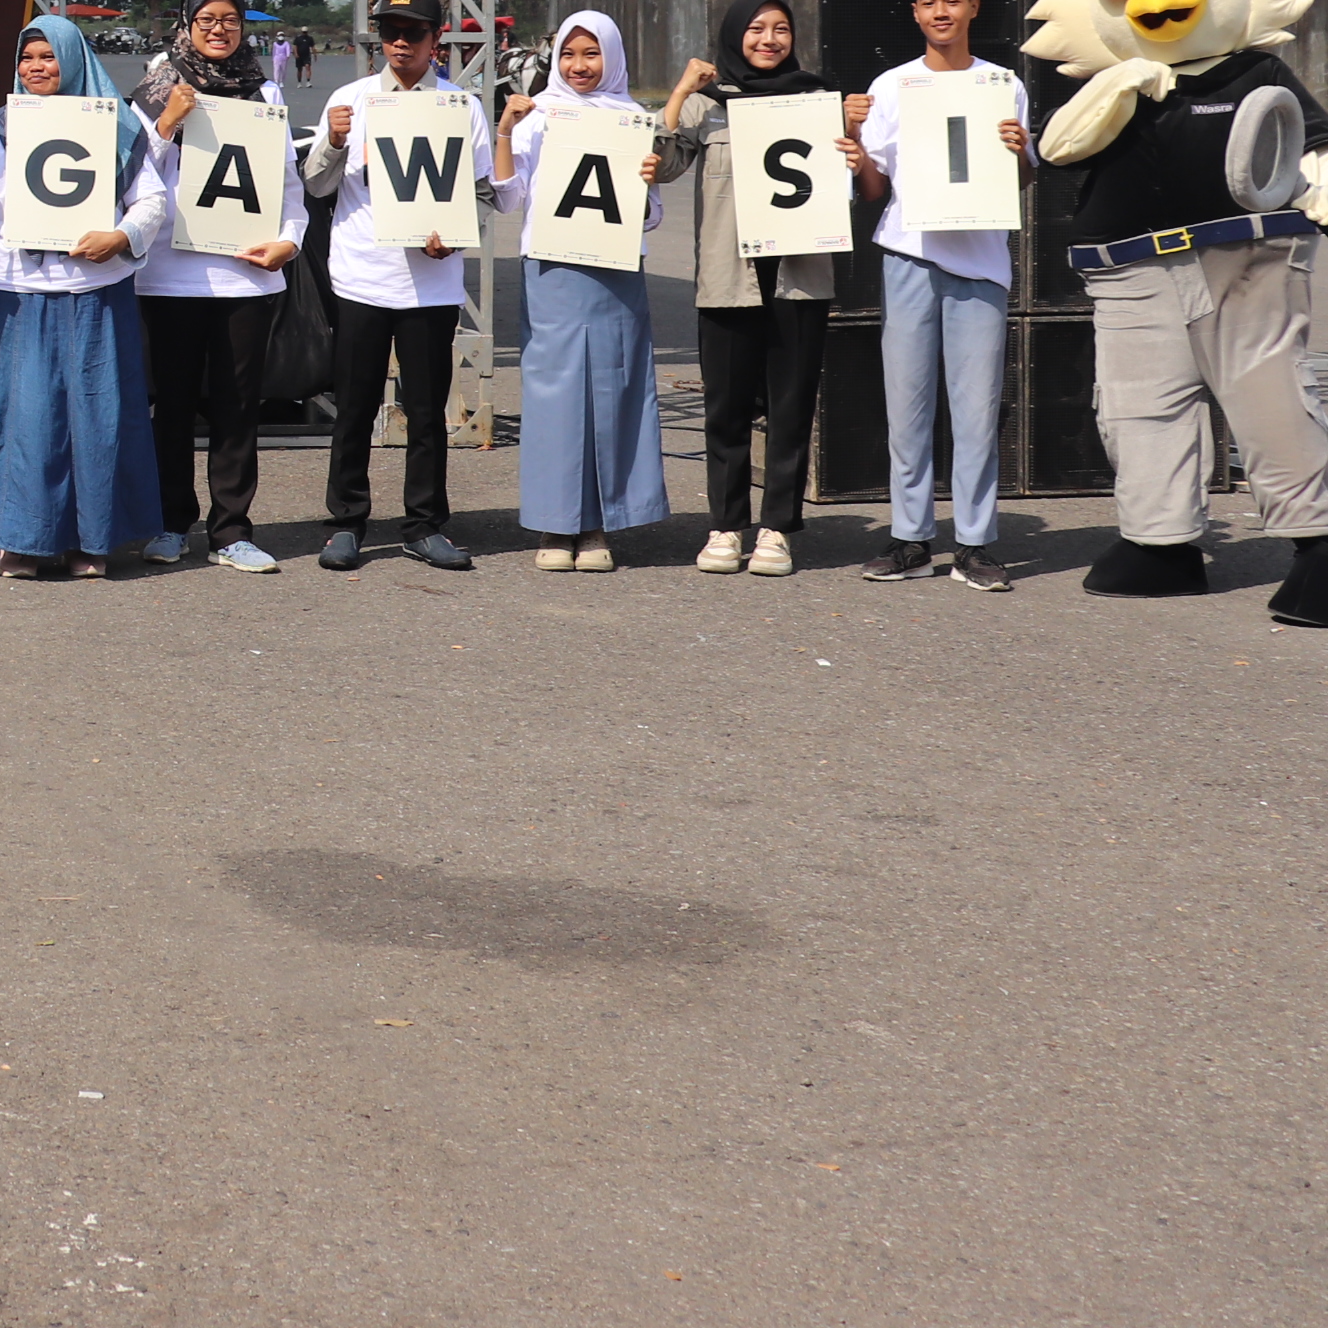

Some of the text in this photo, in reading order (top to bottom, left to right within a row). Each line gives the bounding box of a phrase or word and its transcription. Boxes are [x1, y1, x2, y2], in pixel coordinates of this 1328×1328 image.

[1194, 105, 1233, 113] Wasra
[25, 139, 96, 207] G
[196, 144, 261, 214] A
[375, 137, 463, 202] W
[764, 139, 813, 209] S
[948, 117, 969, 183] I
[555, 154, 622, 224] A
